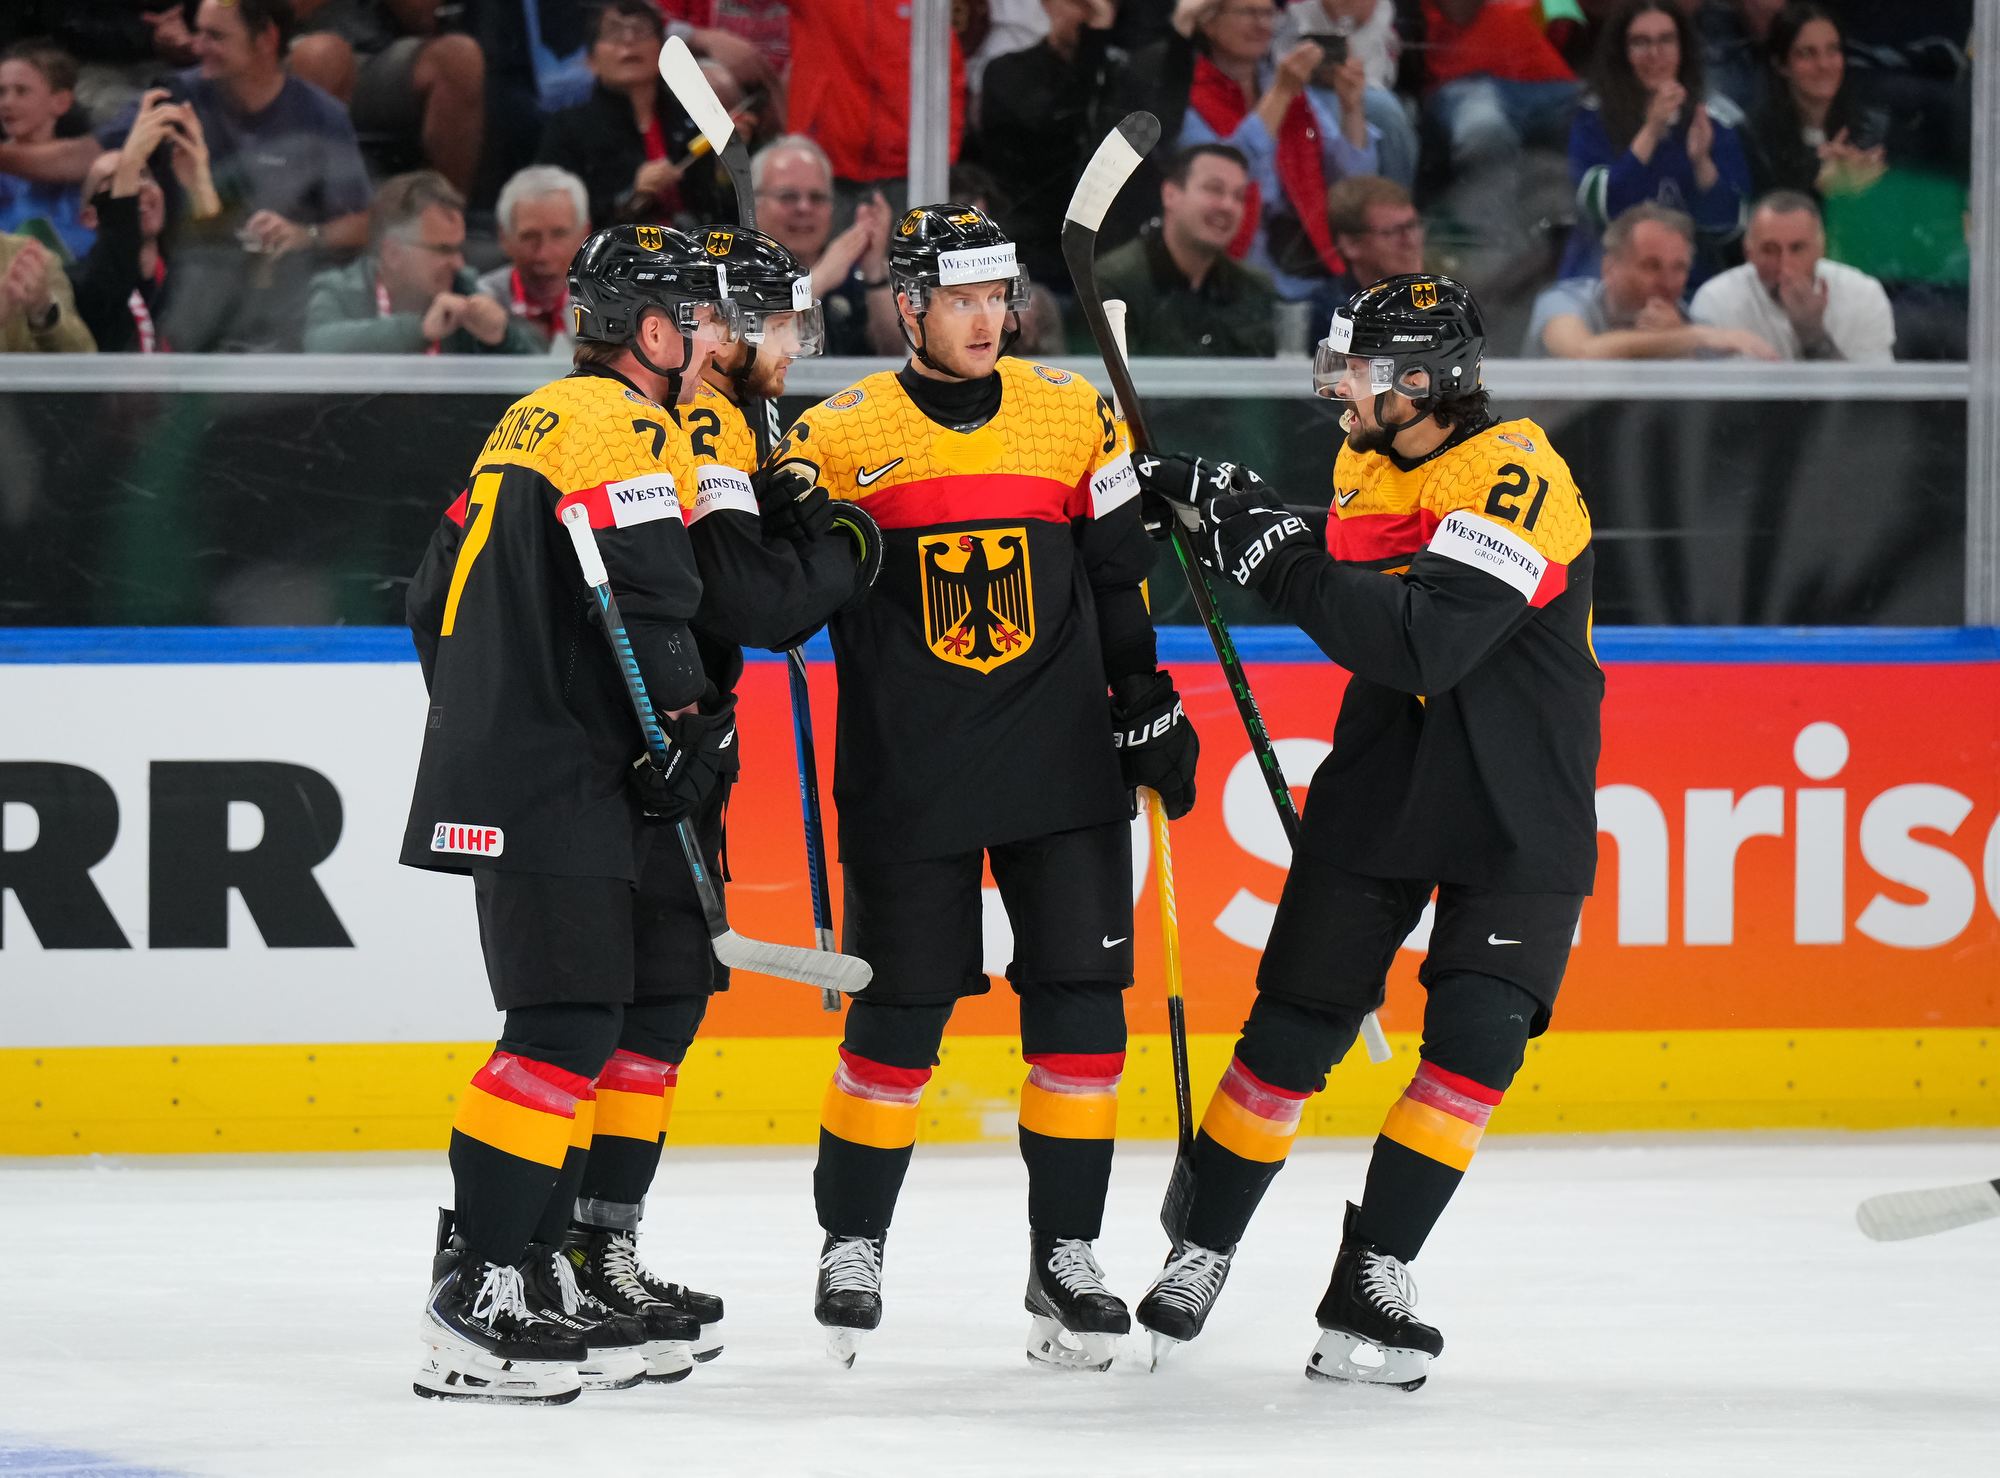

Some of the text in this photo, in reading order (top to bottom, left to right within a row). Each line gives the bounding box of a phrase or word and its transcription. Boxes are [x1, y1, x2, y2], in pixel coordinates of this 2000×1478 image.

[941, 252, 1015, 270] WESTMINSTER
[1392, 334, 1433, 342] BAUER
[632, 418, 667, 461] 7
[696, 491, 722, 506] GROUP
[1484, 462, 1549, 532] 21
[440, 472, 504, 636] 7
[1445, 518, 1540, 580] WESTMINSTER
[1474, 549, 1505, 566] GROUP
[450, 827, 497, 852] IIHF
[540, 1308, 584, 1330] BAUER
